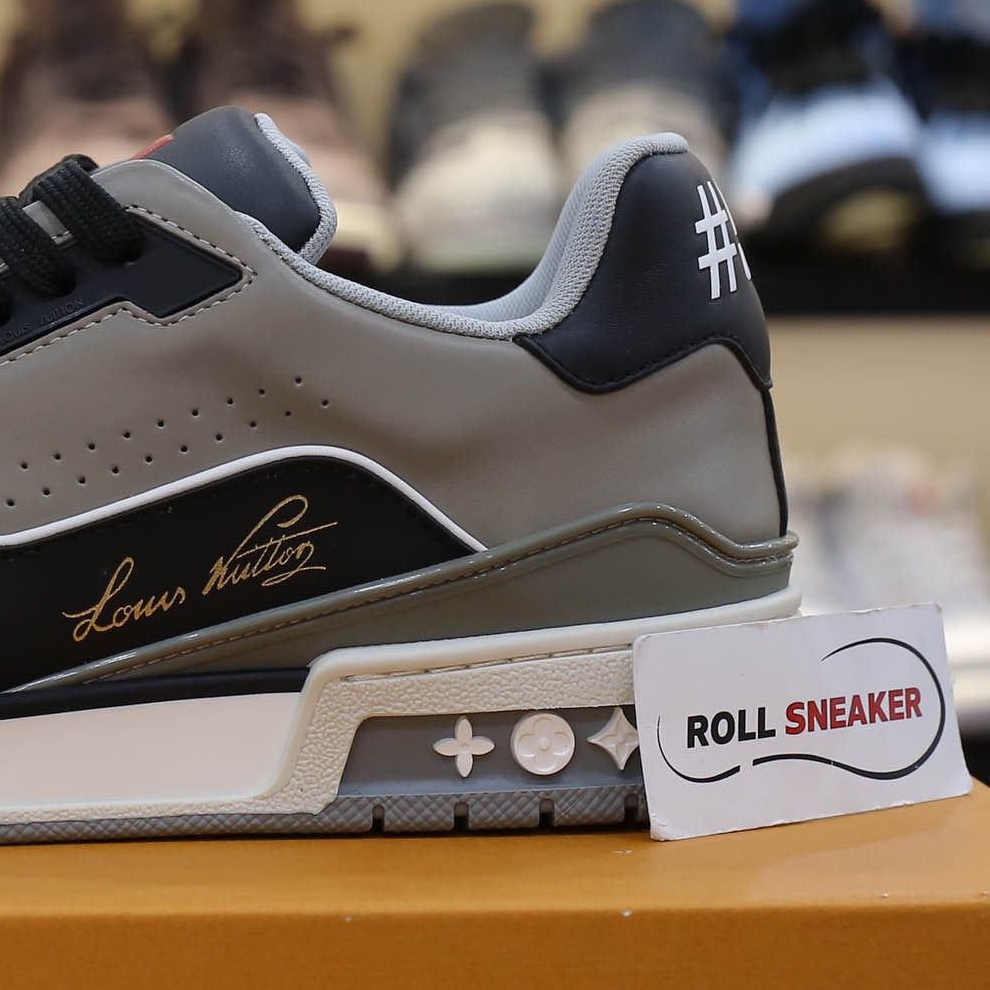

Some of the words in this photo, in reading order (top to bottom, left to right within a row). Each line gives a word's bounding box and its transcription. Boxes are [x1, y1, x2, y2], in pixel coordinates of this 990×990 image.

[62, 557, 186, 642] Louis
[686, 706, 776, 749] ROLL
[785, 686, 923, 736] SNEAKER
